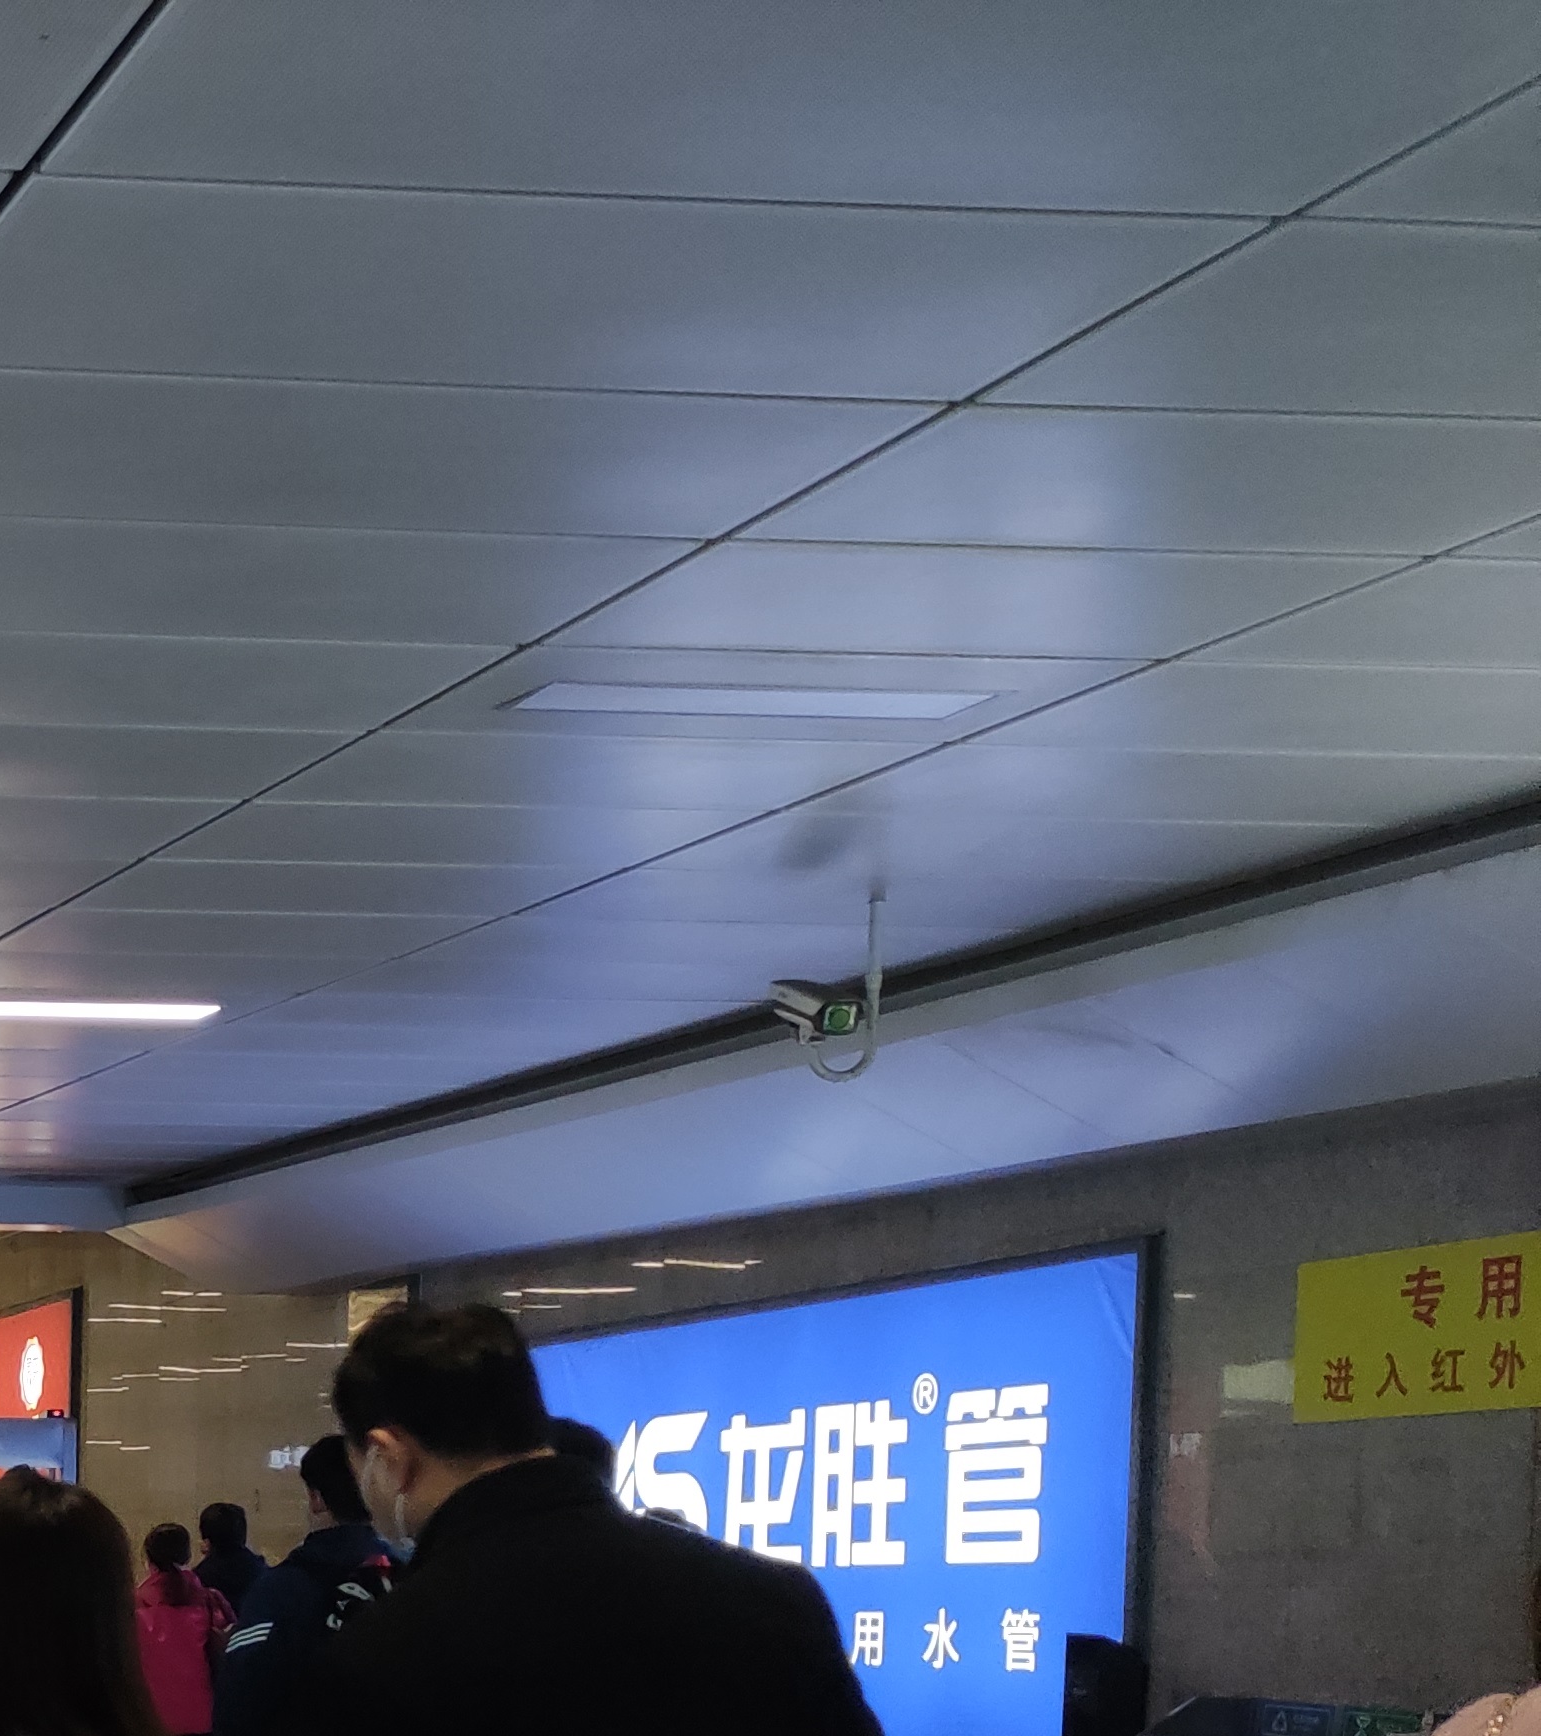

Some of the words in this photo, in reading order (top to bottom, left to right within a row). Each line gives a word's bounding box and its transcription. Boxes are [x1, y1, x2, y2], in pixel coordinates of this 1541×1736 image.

[1400, 1254, 1523, 1330] 专用
[1323, 1340, 1526, 1403] 进入红外
[851, 1607, 1041, 1673] 用水管
